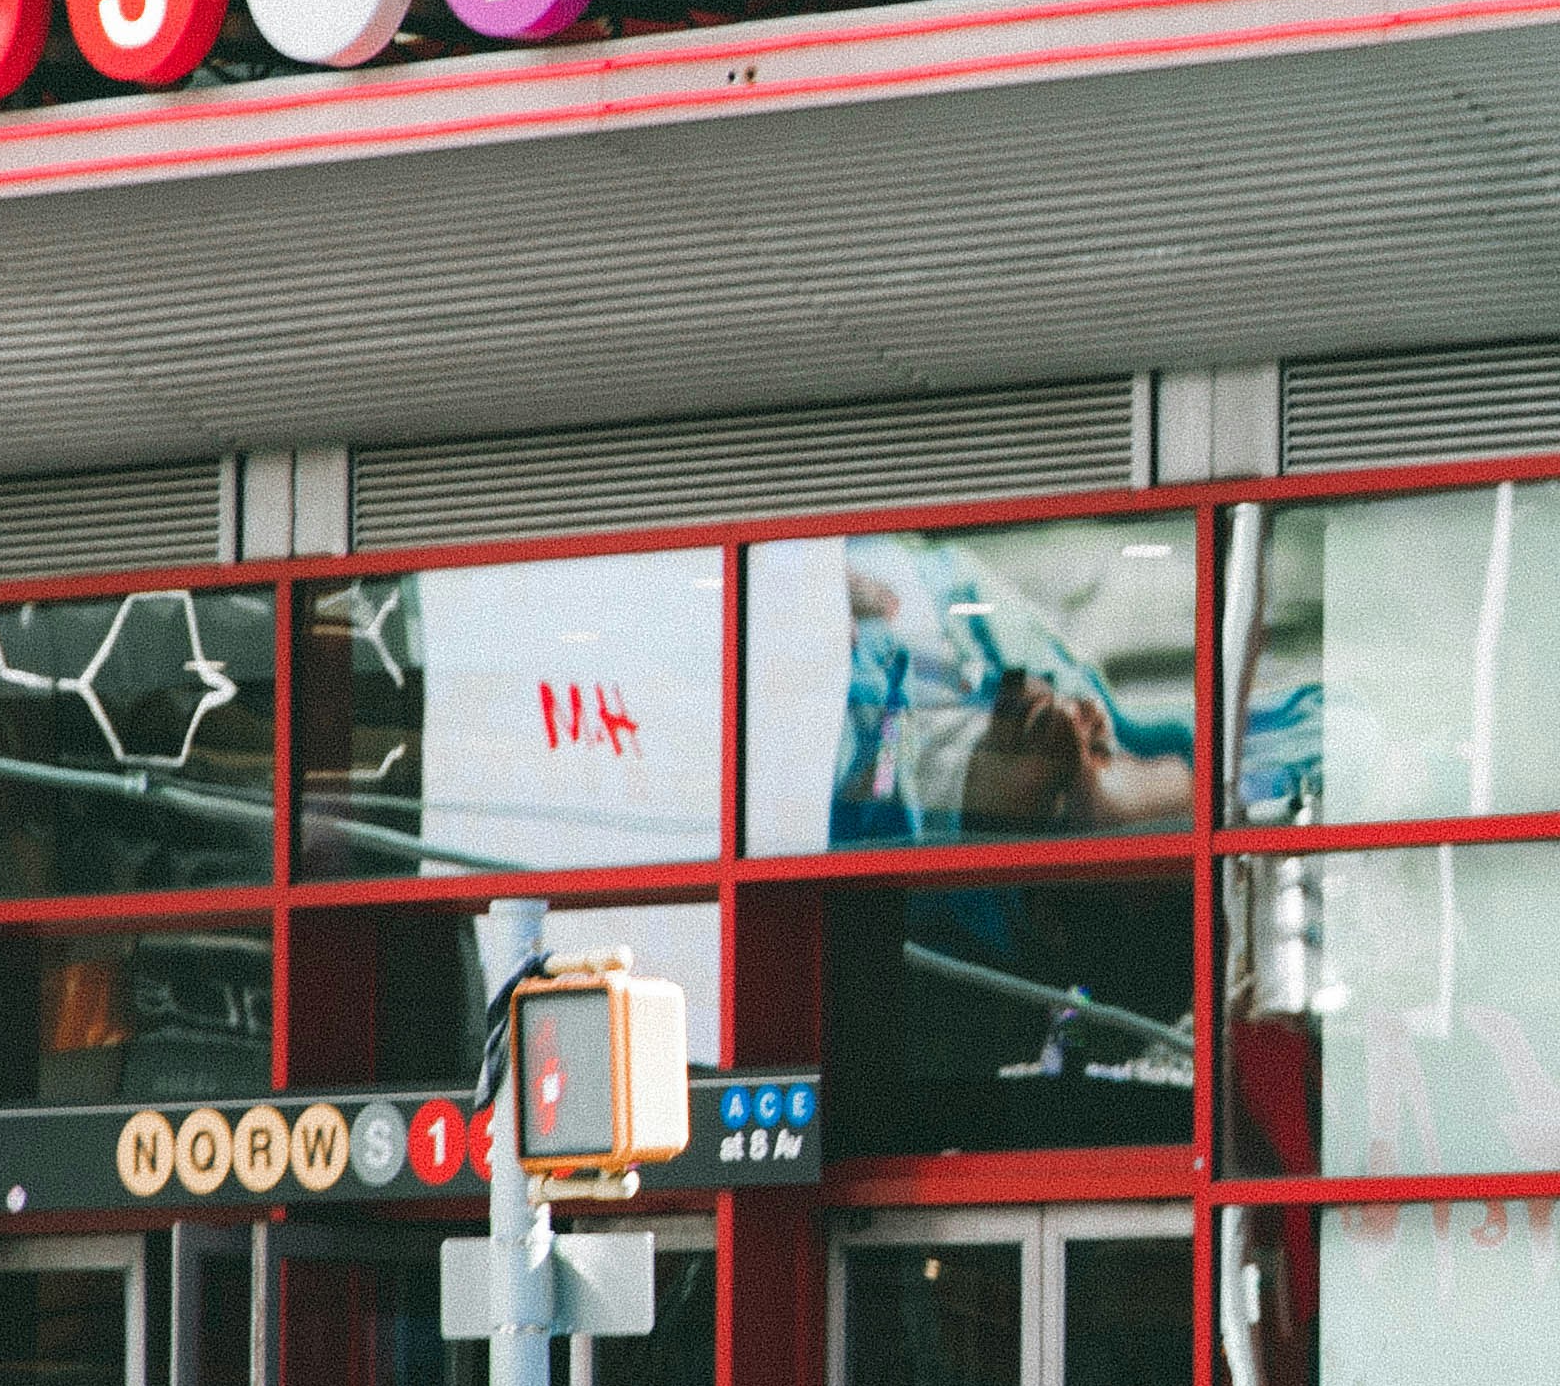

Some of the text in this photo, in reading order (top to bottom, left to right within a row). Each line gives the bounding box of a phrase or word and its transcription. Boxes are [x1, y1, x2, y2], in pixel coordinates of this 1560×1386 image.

[132, 1129, 159, 1176] N
[248, 1127, 274, 1169] R
[302, 1124, 337, 1175] W
[366, 1121, 394, 1171] S
[719, 1130, 746, 1163] at
